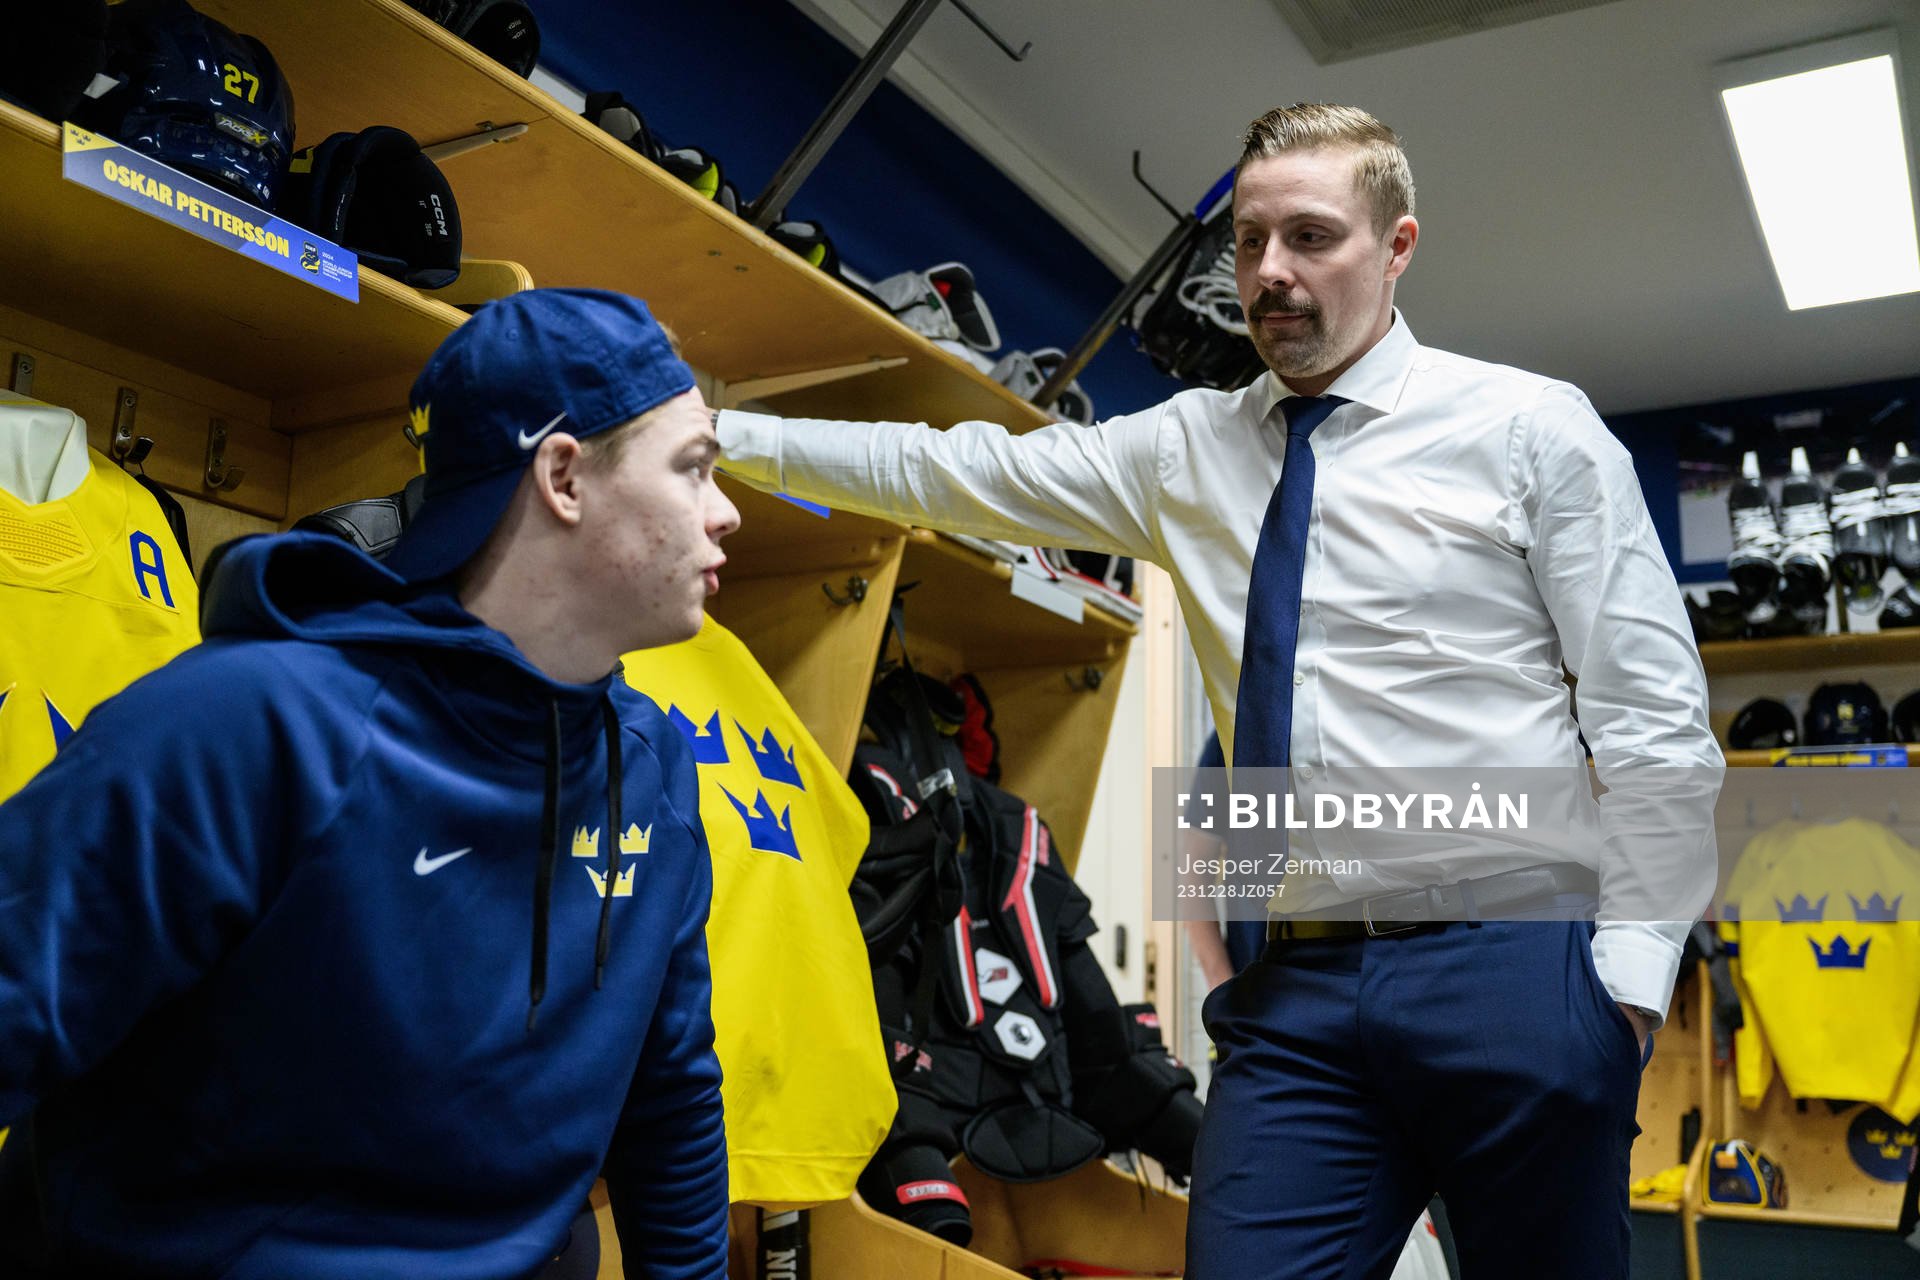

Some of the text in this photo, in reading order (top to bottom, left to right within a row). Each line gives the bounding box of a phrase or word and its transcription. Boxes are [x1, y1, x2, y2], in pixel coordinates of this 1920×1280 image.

[224, 63, 259, 104] 27
[103, 159, 289, 258] OSKAR PETTERSSON
[430, 193, 448, 236] CCM
[129, 529, 175, 608] A
